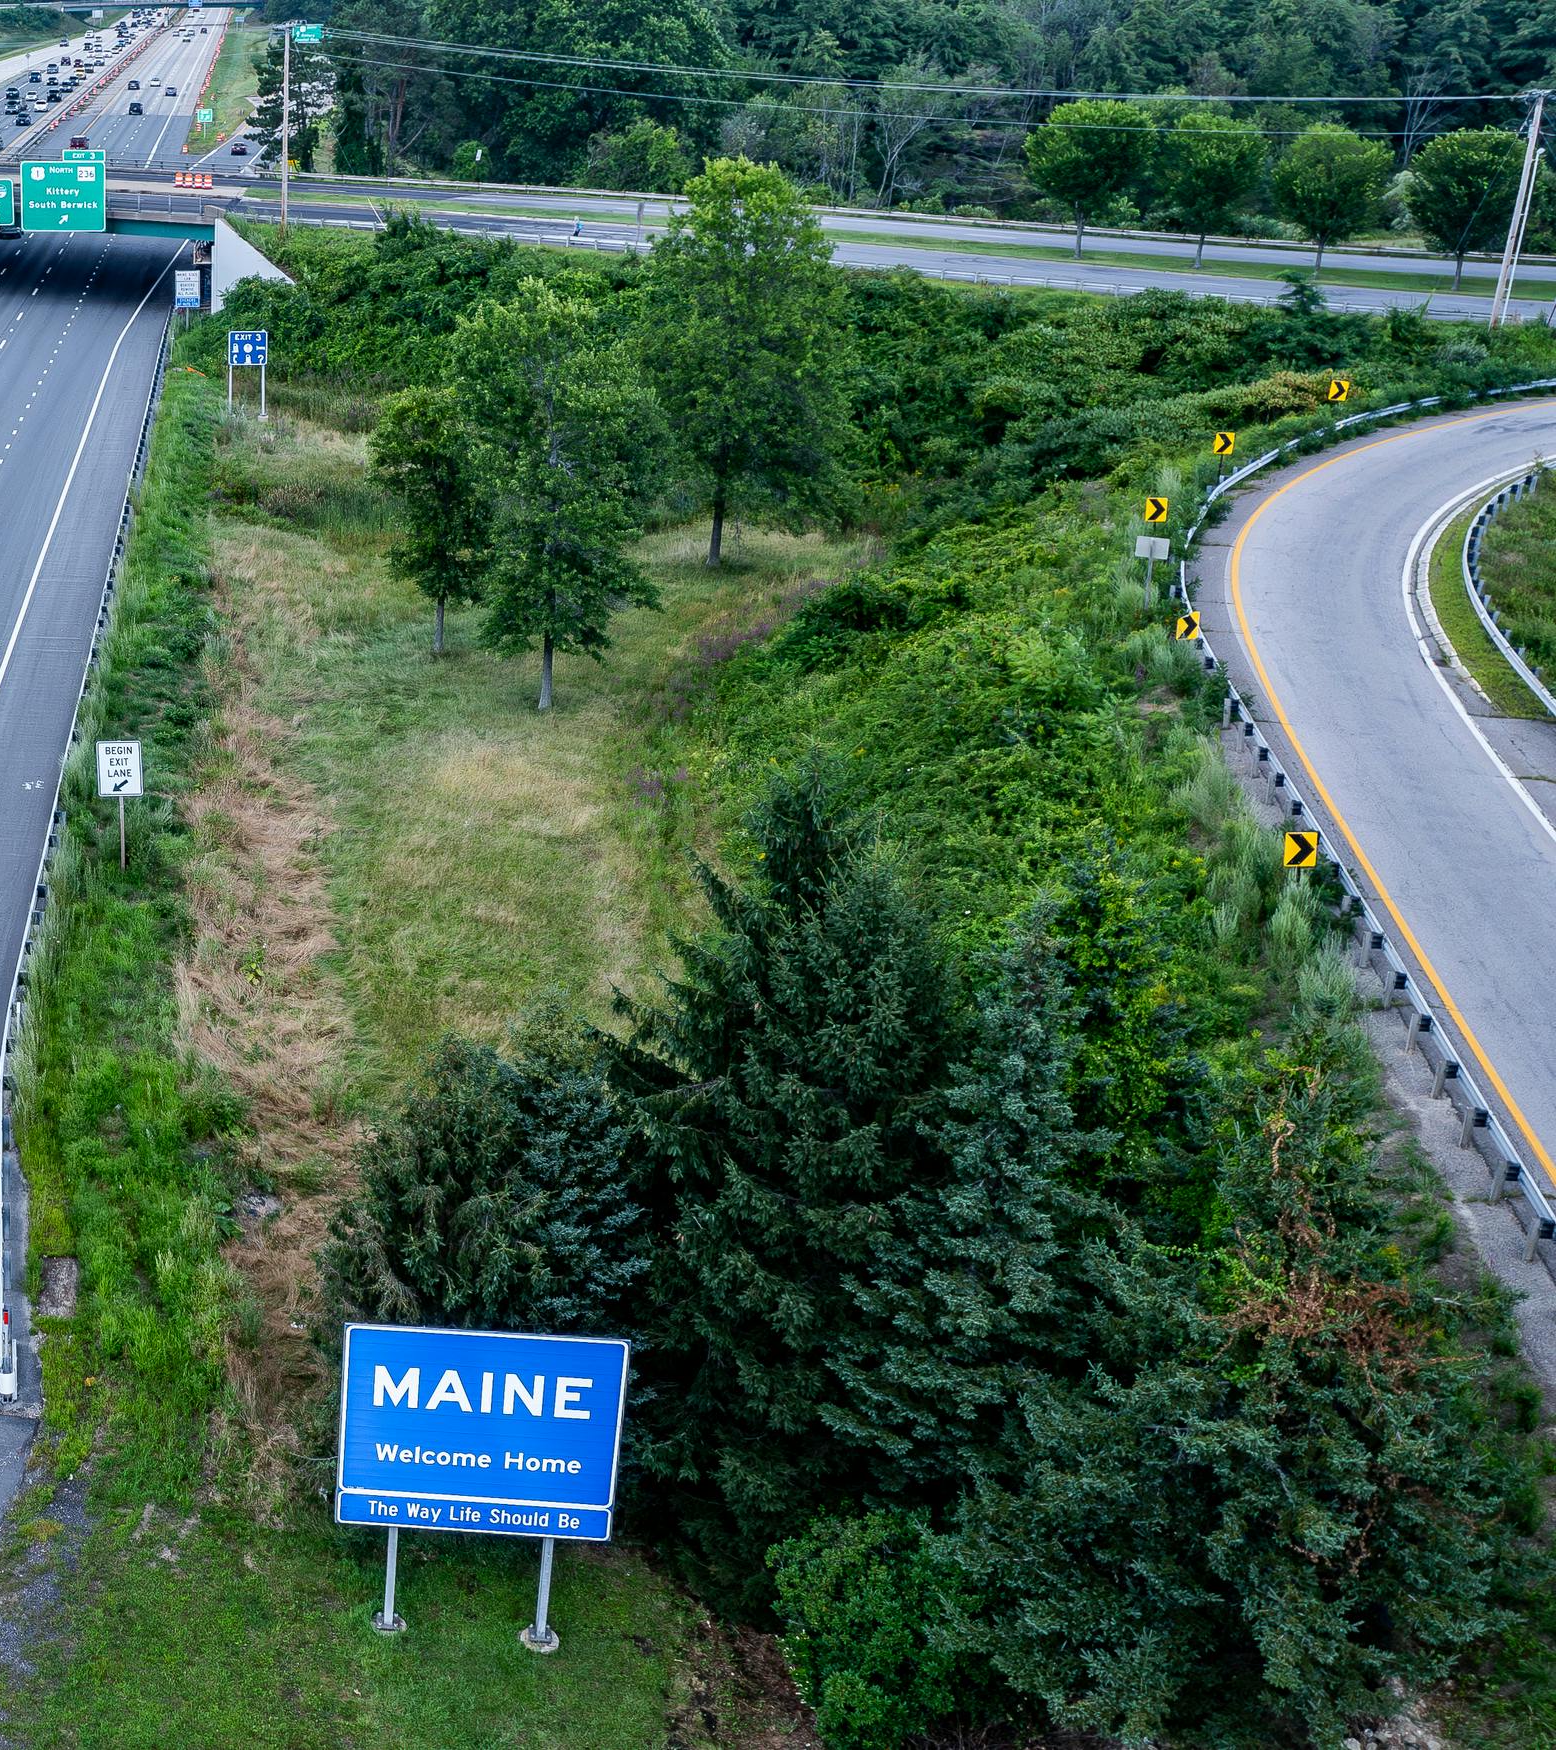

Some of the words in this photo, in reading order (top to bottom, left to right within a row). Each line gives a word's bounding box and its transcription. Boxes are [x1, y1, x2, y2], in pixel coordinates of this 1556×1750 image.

[49, 166, 73, 174] NORTH
[78, 170, 94, 178] 236
[46, 187, 80, 197] Kittery
[29, 200, 57, 209] South
[60, 200, 98, 209] Berwick
[235, 333, 252, 341] EXIT
[255, 333, 262, 342] 3
[105, 746, 133, 755] BEGIN
[109, 758, 129, 767] EXIT
[108, 769, 133, 778] LANE
[372, 1364, 593, 1420] MAINE
[375, 1443, 492, 1469] Welcome
[503, 1451, 582, 1474] Home
[368, 1500, 399, 1517] The
[406, 1502, 442, 1523] Way
[449, 1505, 482, 1523] Life
[489, 1508, 549, 1528] Should
[558, 1513, 580, 1529] Be
